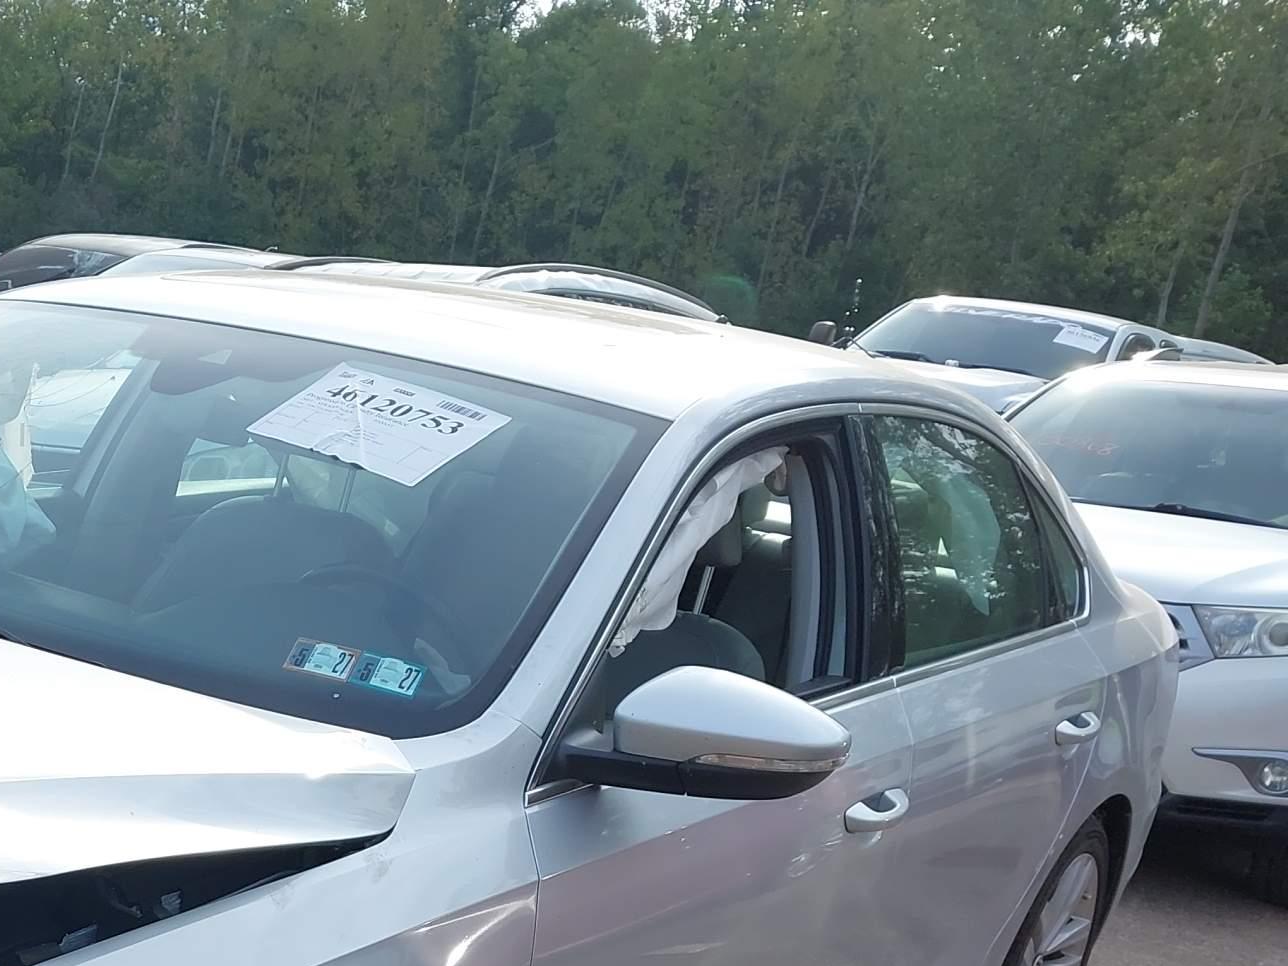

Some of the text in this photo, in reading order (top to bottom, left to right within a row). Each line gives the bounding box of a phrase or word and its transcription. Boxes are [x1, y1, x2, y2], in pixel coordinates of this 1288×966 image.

[325, 384, 465, 435] 46120753
[331, 652, 355, 677] 27
[398, 667, 422, 692] 27
